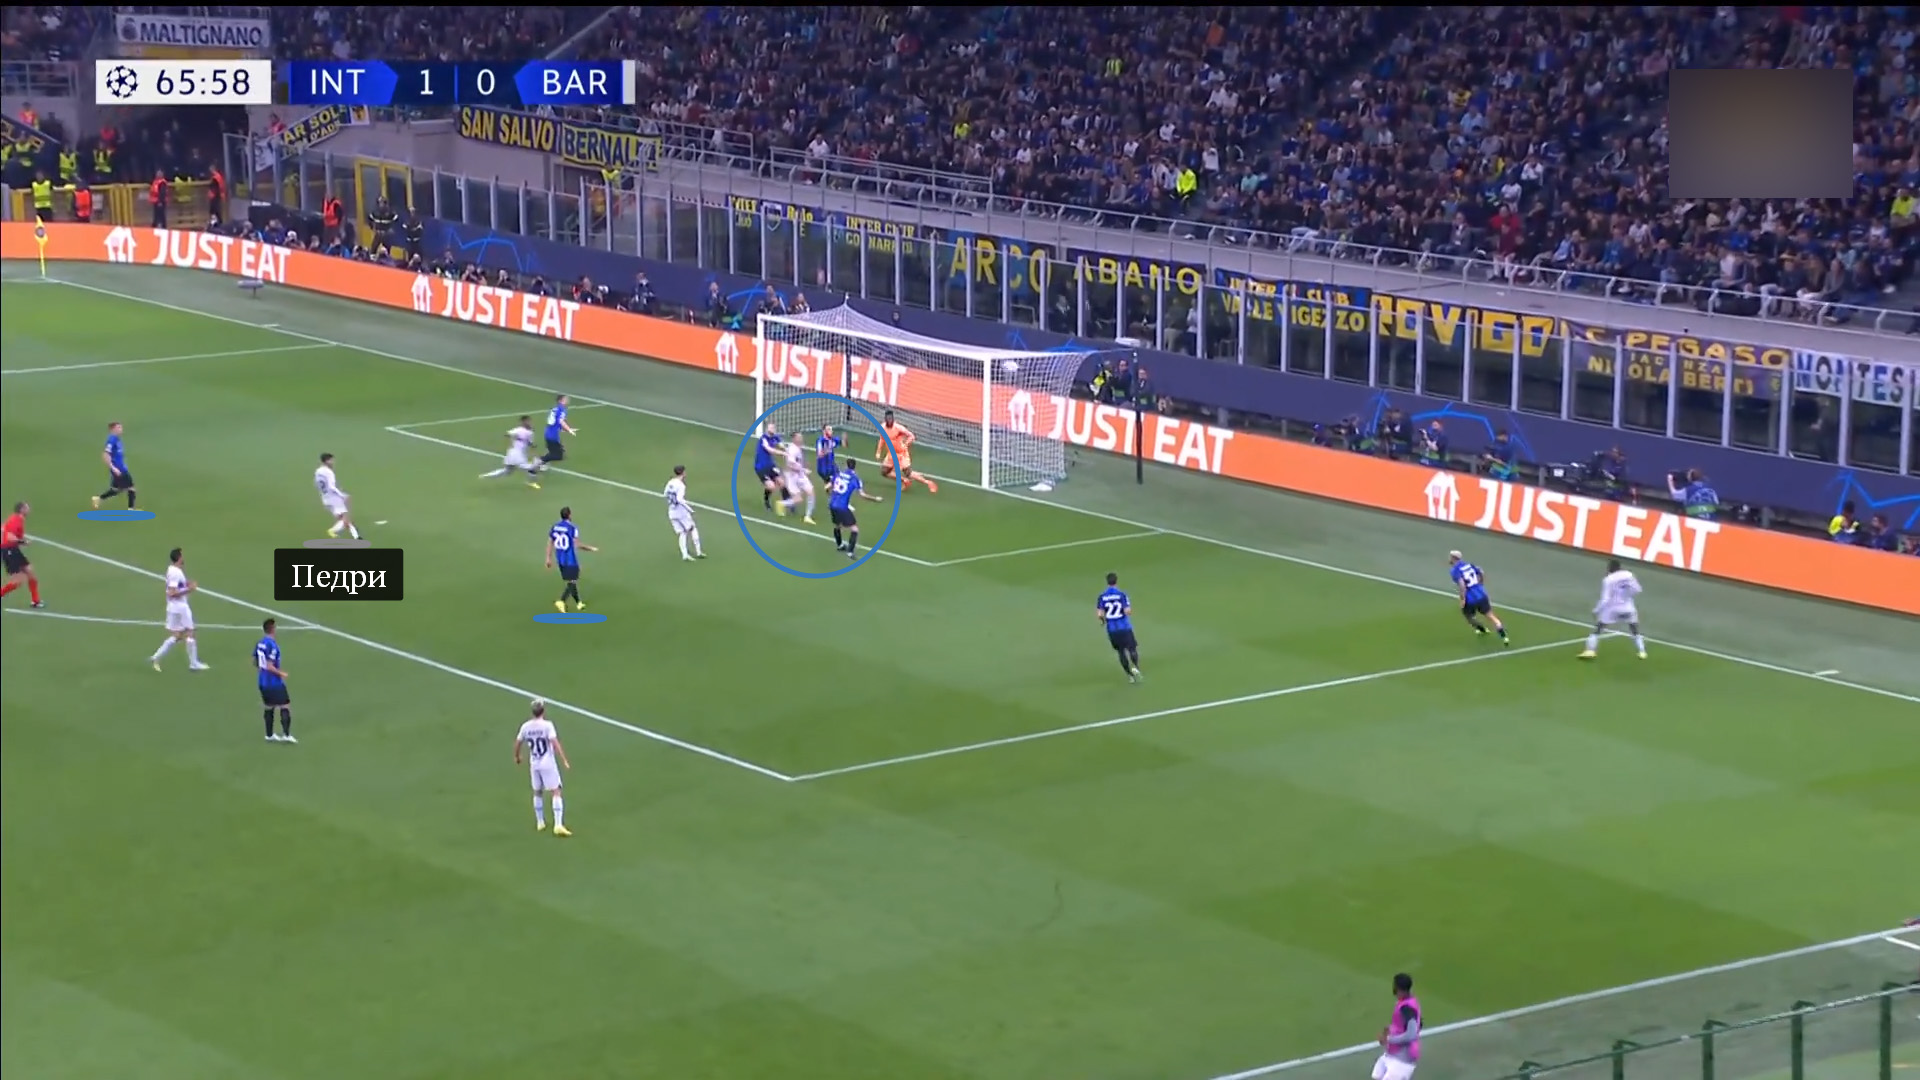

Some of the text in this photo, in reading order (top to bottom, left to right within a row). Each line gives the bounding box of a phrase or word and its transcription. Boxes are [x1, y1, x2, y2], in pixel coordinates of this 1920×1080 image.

[140, 22, 262, 46] MALTIGNANO
[461, 106, 555, 152] SAN SALVO
[564, 129, 657, 168] BERNAL
[846, 215, 881, 234] INTER
[152, 227, 292, 284] JUST EAT
[1073, 255, 1202, 296] ABANO
[441, 279, 581, 341] JUST EAT
[1221, 290, 1273, 321] VALE
[1306, 288, 1350, 306] CLB
[1371, 293, 1554, 358] ROVIGO
[1626, 331, 1791, 369] PEGASO
[750, 336, 907, 406] JUST EAT
[1588, 355, 1671, 384] NIOLA
[1047, 396, 1235, 475] JUST EAT
[552, 531, 569, 551] 20
[1473, 478, 1721, 573] JUST EAT
[1104, 601, 1123, 619] 22
[526, 737, 548, 757] 20
